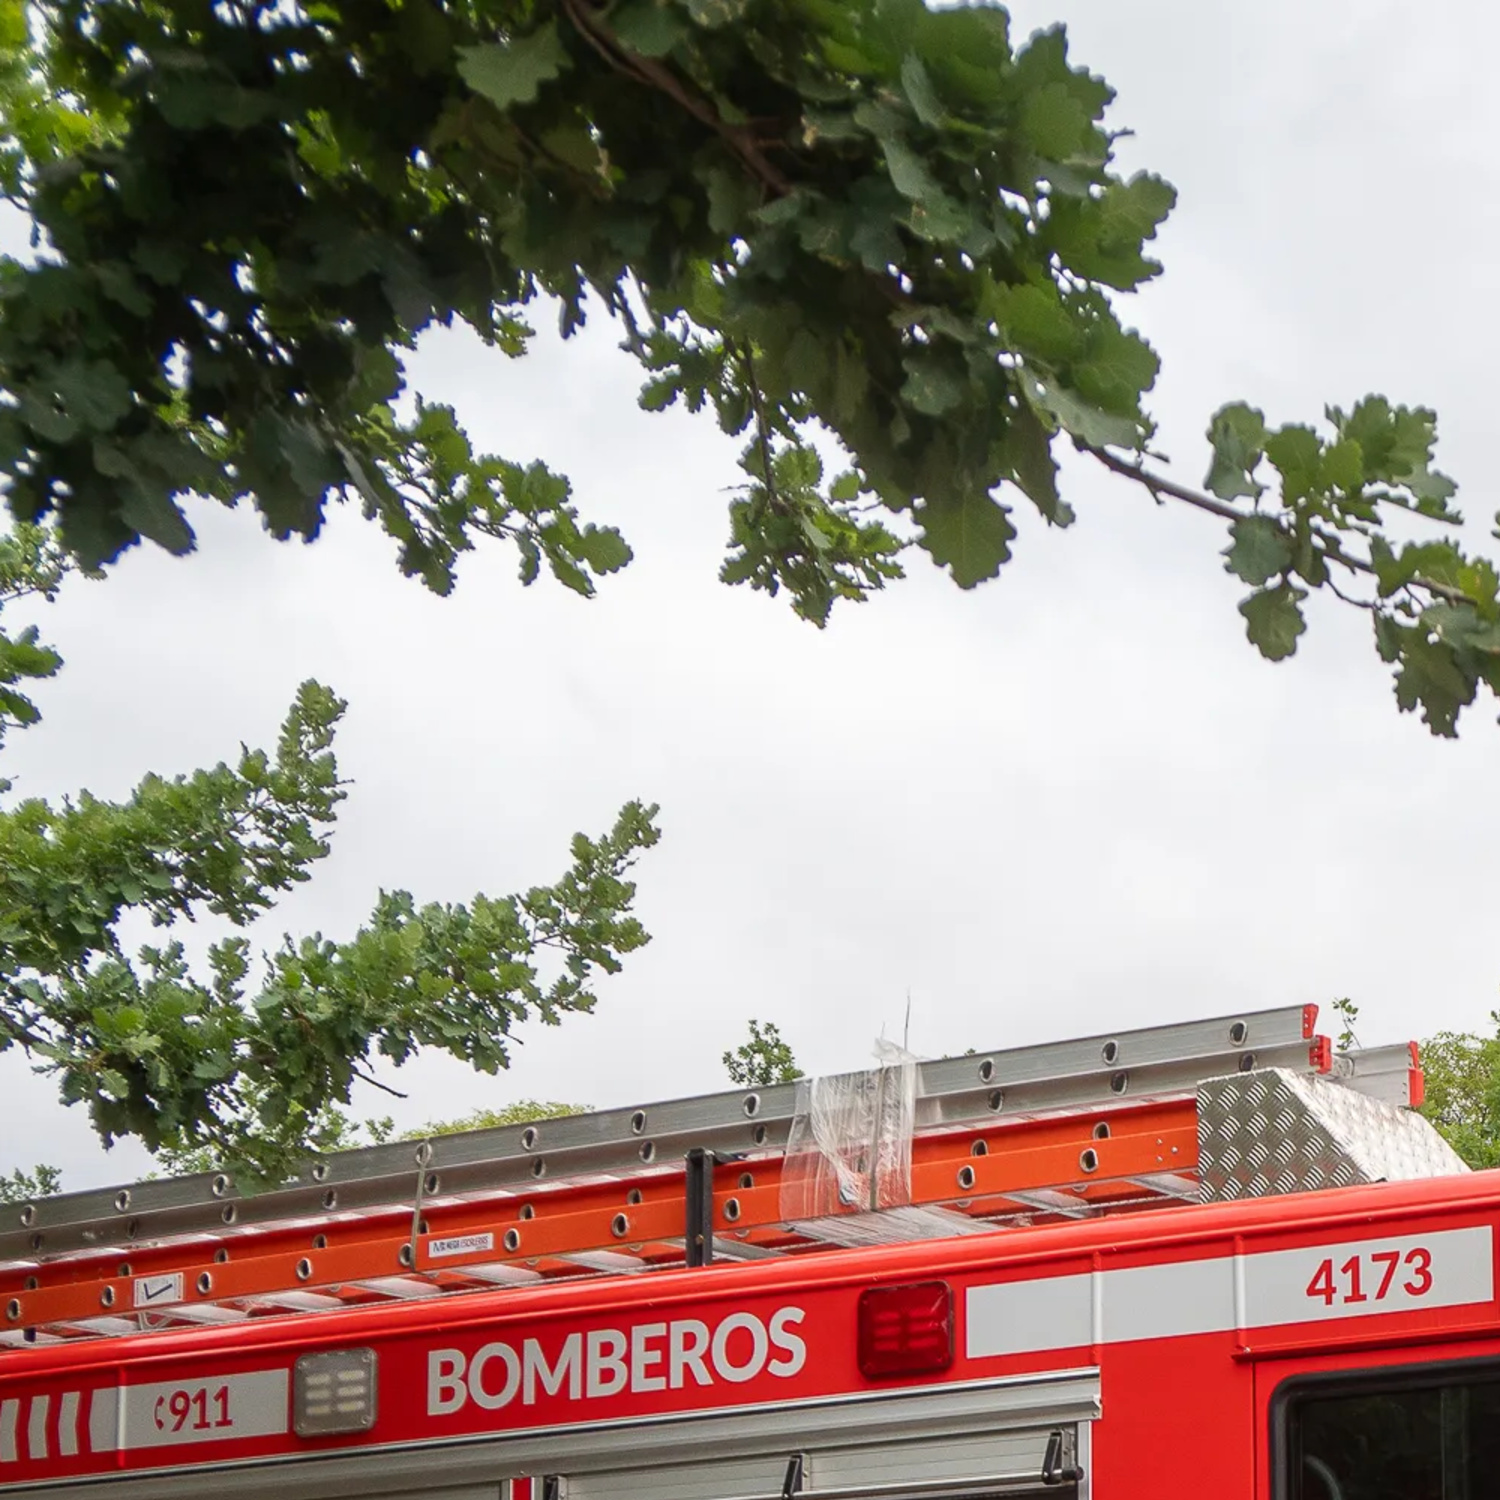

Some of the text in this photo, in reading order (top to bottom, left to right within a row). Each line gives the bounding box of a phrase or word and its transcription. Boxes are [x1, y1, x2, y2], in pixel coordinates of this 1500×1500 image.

[1306, 1247, 1433, 1306] 4173
[427, 1305, 808, 1417] BOMBEROS
[169, 1385, 233, 1432] 911
